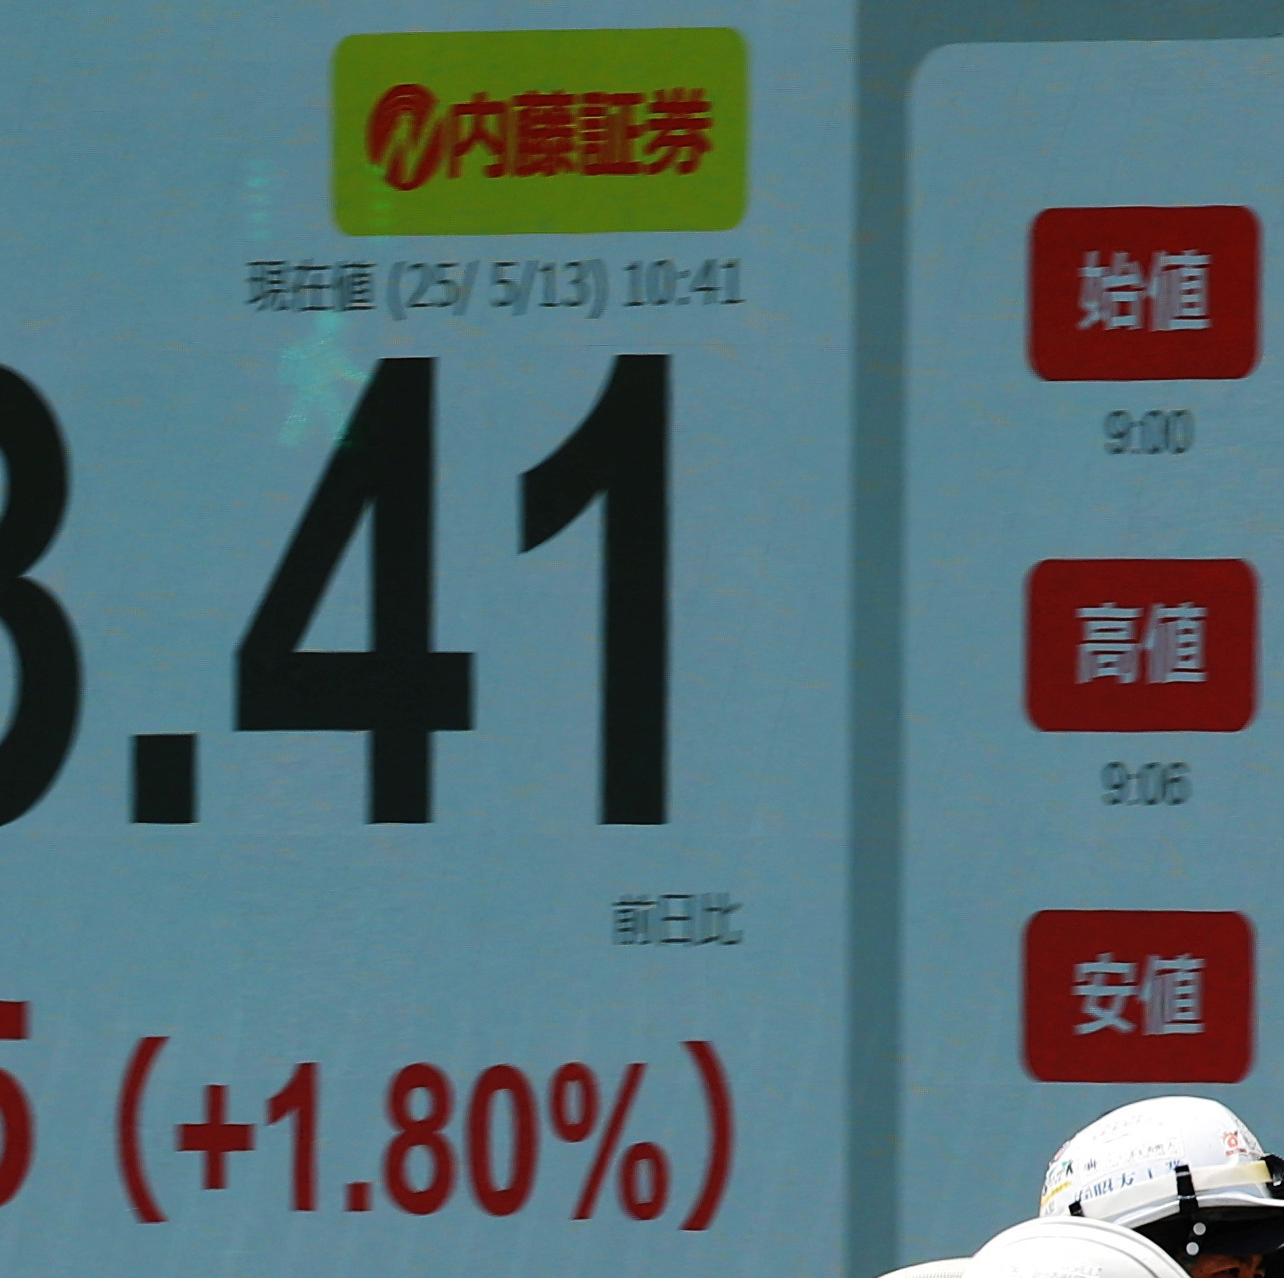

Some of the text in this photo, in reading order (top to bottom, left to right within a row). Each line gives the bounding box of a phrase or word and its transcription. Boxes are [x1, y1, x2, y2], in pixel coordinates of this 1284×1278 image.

[445, 88, 713, 179] 内藤証券
[246, 259, 377, 312] 現在値
[623, 259, 744, 307] 10:41
[1078, 250, 1210, 331] 始値
[1103, 409, 1194, 456] 9:00
[1075, 602, 1207, 684] 高値
[1101, 761, 1191, 806] 9:06
[611, 893, 744, 946] 前日比
[1072, 952, 1205, 1035] 安値
[117, 1036, 735, 1231] (+1.80%)
